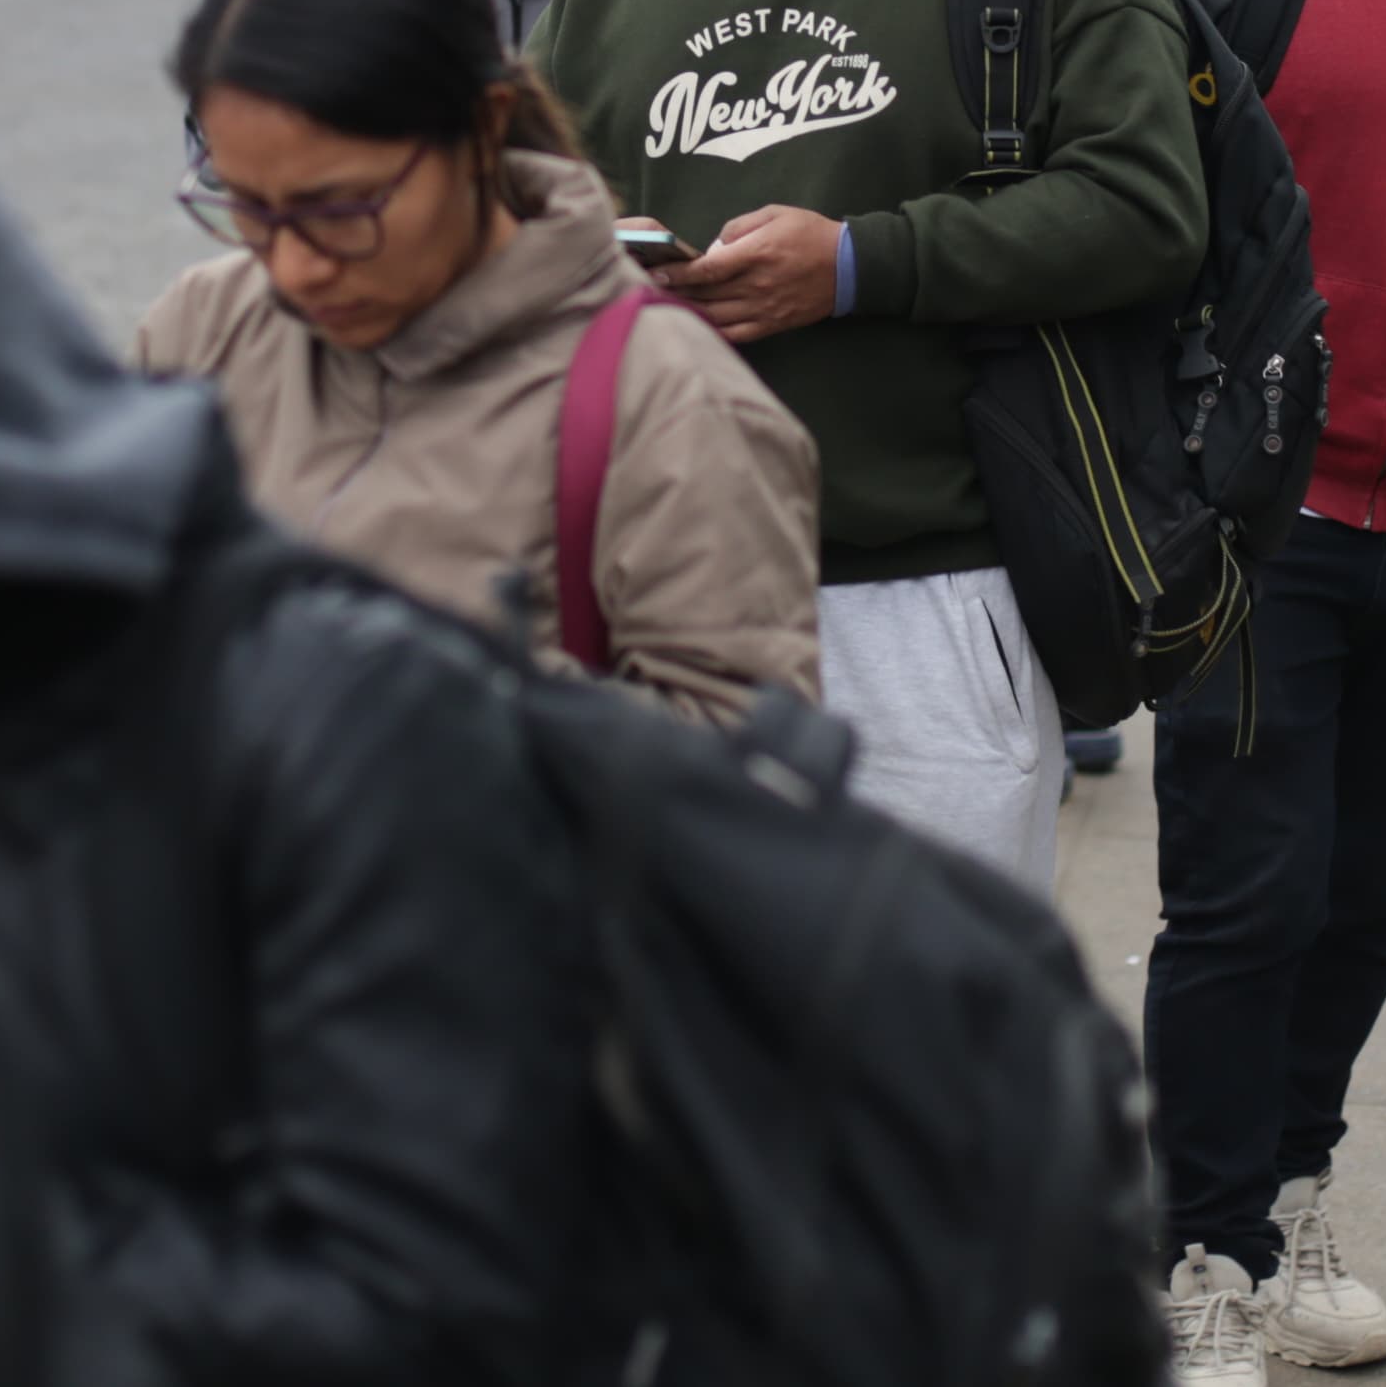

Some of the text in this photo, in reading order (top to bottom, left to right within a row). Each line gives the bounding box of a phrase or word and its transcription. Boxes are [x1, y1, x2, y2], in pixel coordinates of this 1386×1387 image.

[686, 8, 858, 59] WEST PARK
[645, 53, 898, 159] New York
